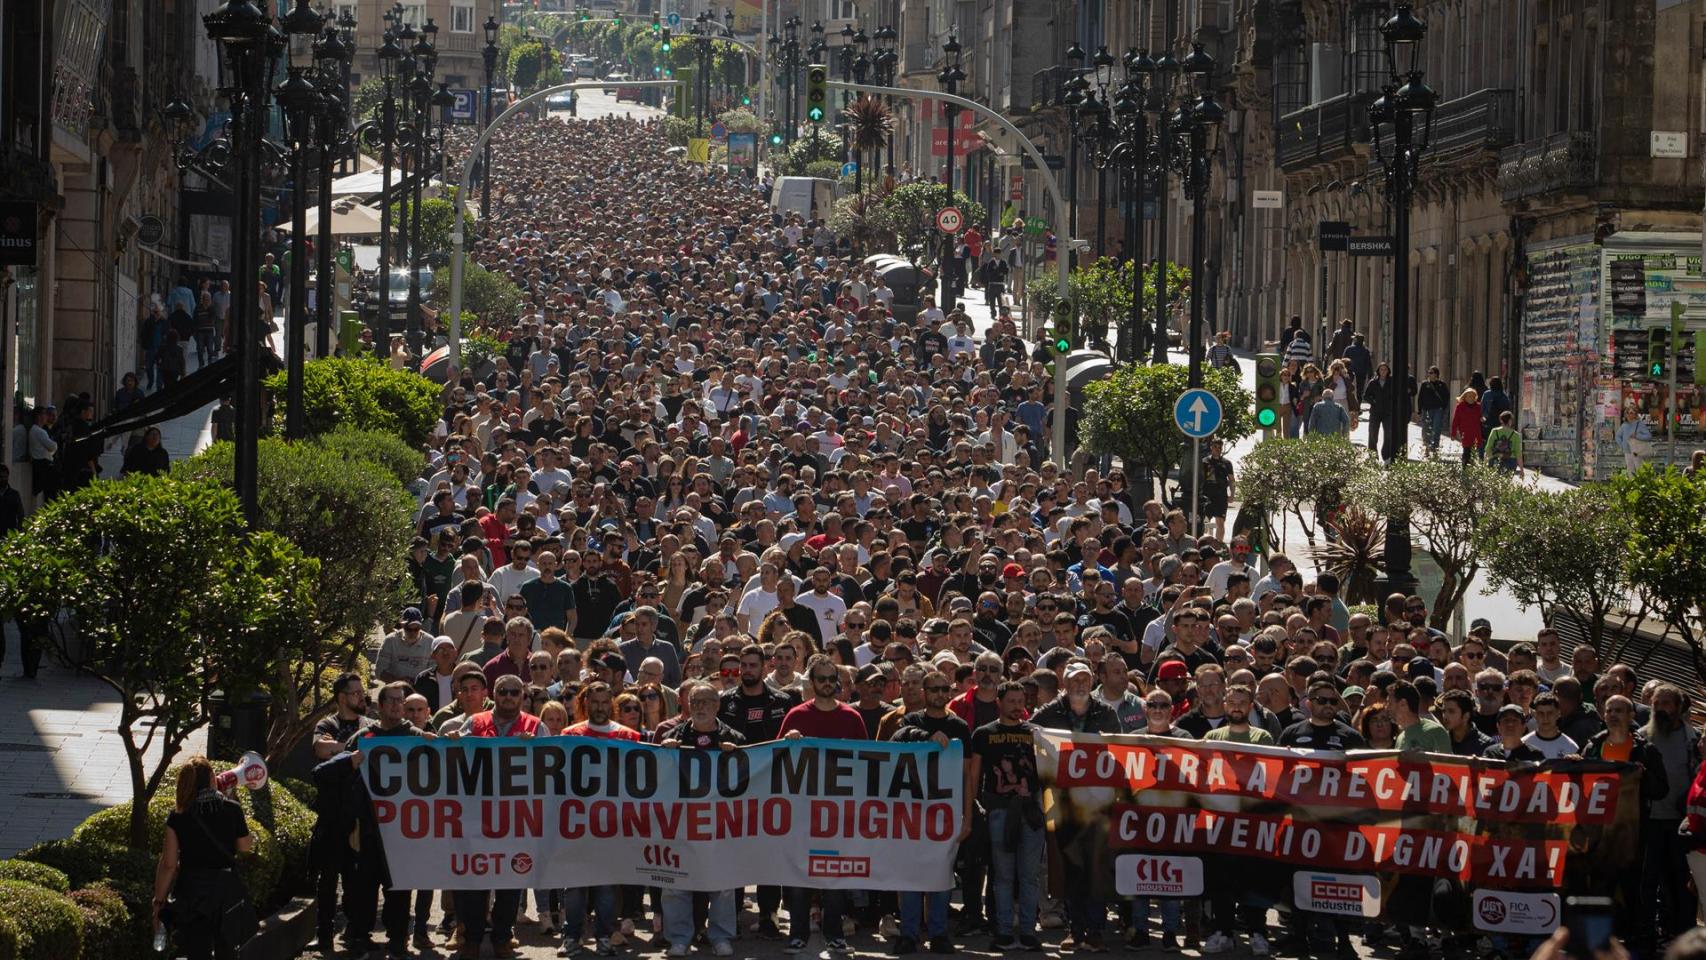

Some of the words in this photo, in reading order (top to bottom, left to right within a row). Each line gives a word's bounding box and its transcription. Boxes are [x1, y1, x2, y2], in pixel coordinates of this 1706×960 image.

[454, 94, 468, 110] P
[941, 215, 958, 224] 40
[1350, 242, 1391, 250] BERSHKA
[988, 734, 1005, 745] PULP
[368, 745, 657, 799] COMERCIO
[679, 749, 750, 799] DO
[771, 747, 953, 800] METAL
[1068, 749, 1226, 789] CONTRA
[1246, 761, 1268, 793] A
[1290, 764, 1610, 815] PRECARIEDADE
[374, 799, 463, 839] POR
[481, 799, 543, 839] UN
[559, 797, 792, 841] CONVENIO
[810, 799, 954, 841] DIGNO
[1119, 810, 1321, 860] CONVENIO
[1344, 831, 1470, 873] DIGNO
[1488, 845, 1560, 880] XA!
[643, 845, 680, 867] CIG
[451, 853, 506, 875] UGT
[813, 860, 867, 874] CCOO
[1137, 859, 1183, 882] CIG
[1137, 883, 1183, 893] INDUSTRIA
[1314, 884, 1360, 899] CCOO
[1312, 899, 1362, 912] industria
[1482, 900, 1503, 913] UGT
[1510, 902, 1530, 912] FICA
